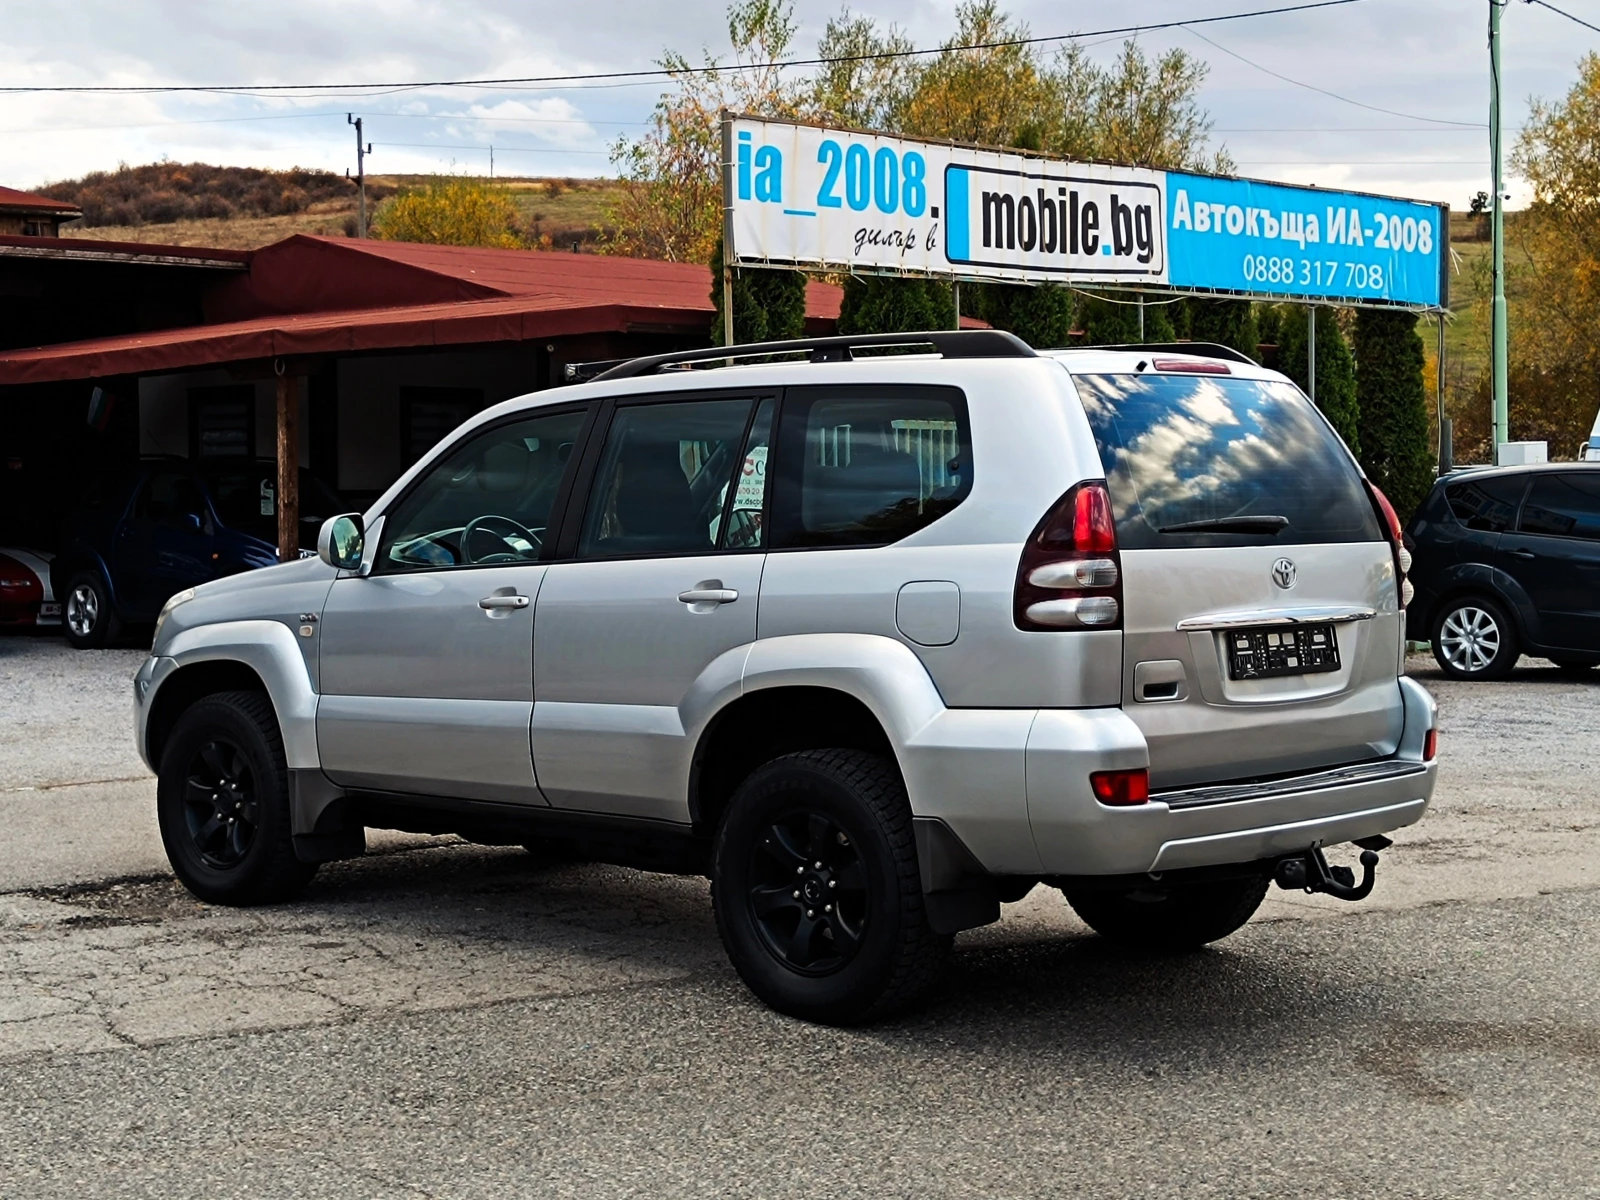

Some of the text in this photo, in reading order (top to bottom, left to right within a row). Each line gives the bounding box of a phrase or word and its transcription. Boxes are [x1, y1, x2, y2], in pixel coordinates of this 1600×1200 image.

[854, 227, 916, 257] дилър
[982, 187, 1152, 264] mobile.bg
[1172, 188, 1433, 255] Автокъща ИА-2008
[1243, 254, 1384, 290] 0888 317 708
